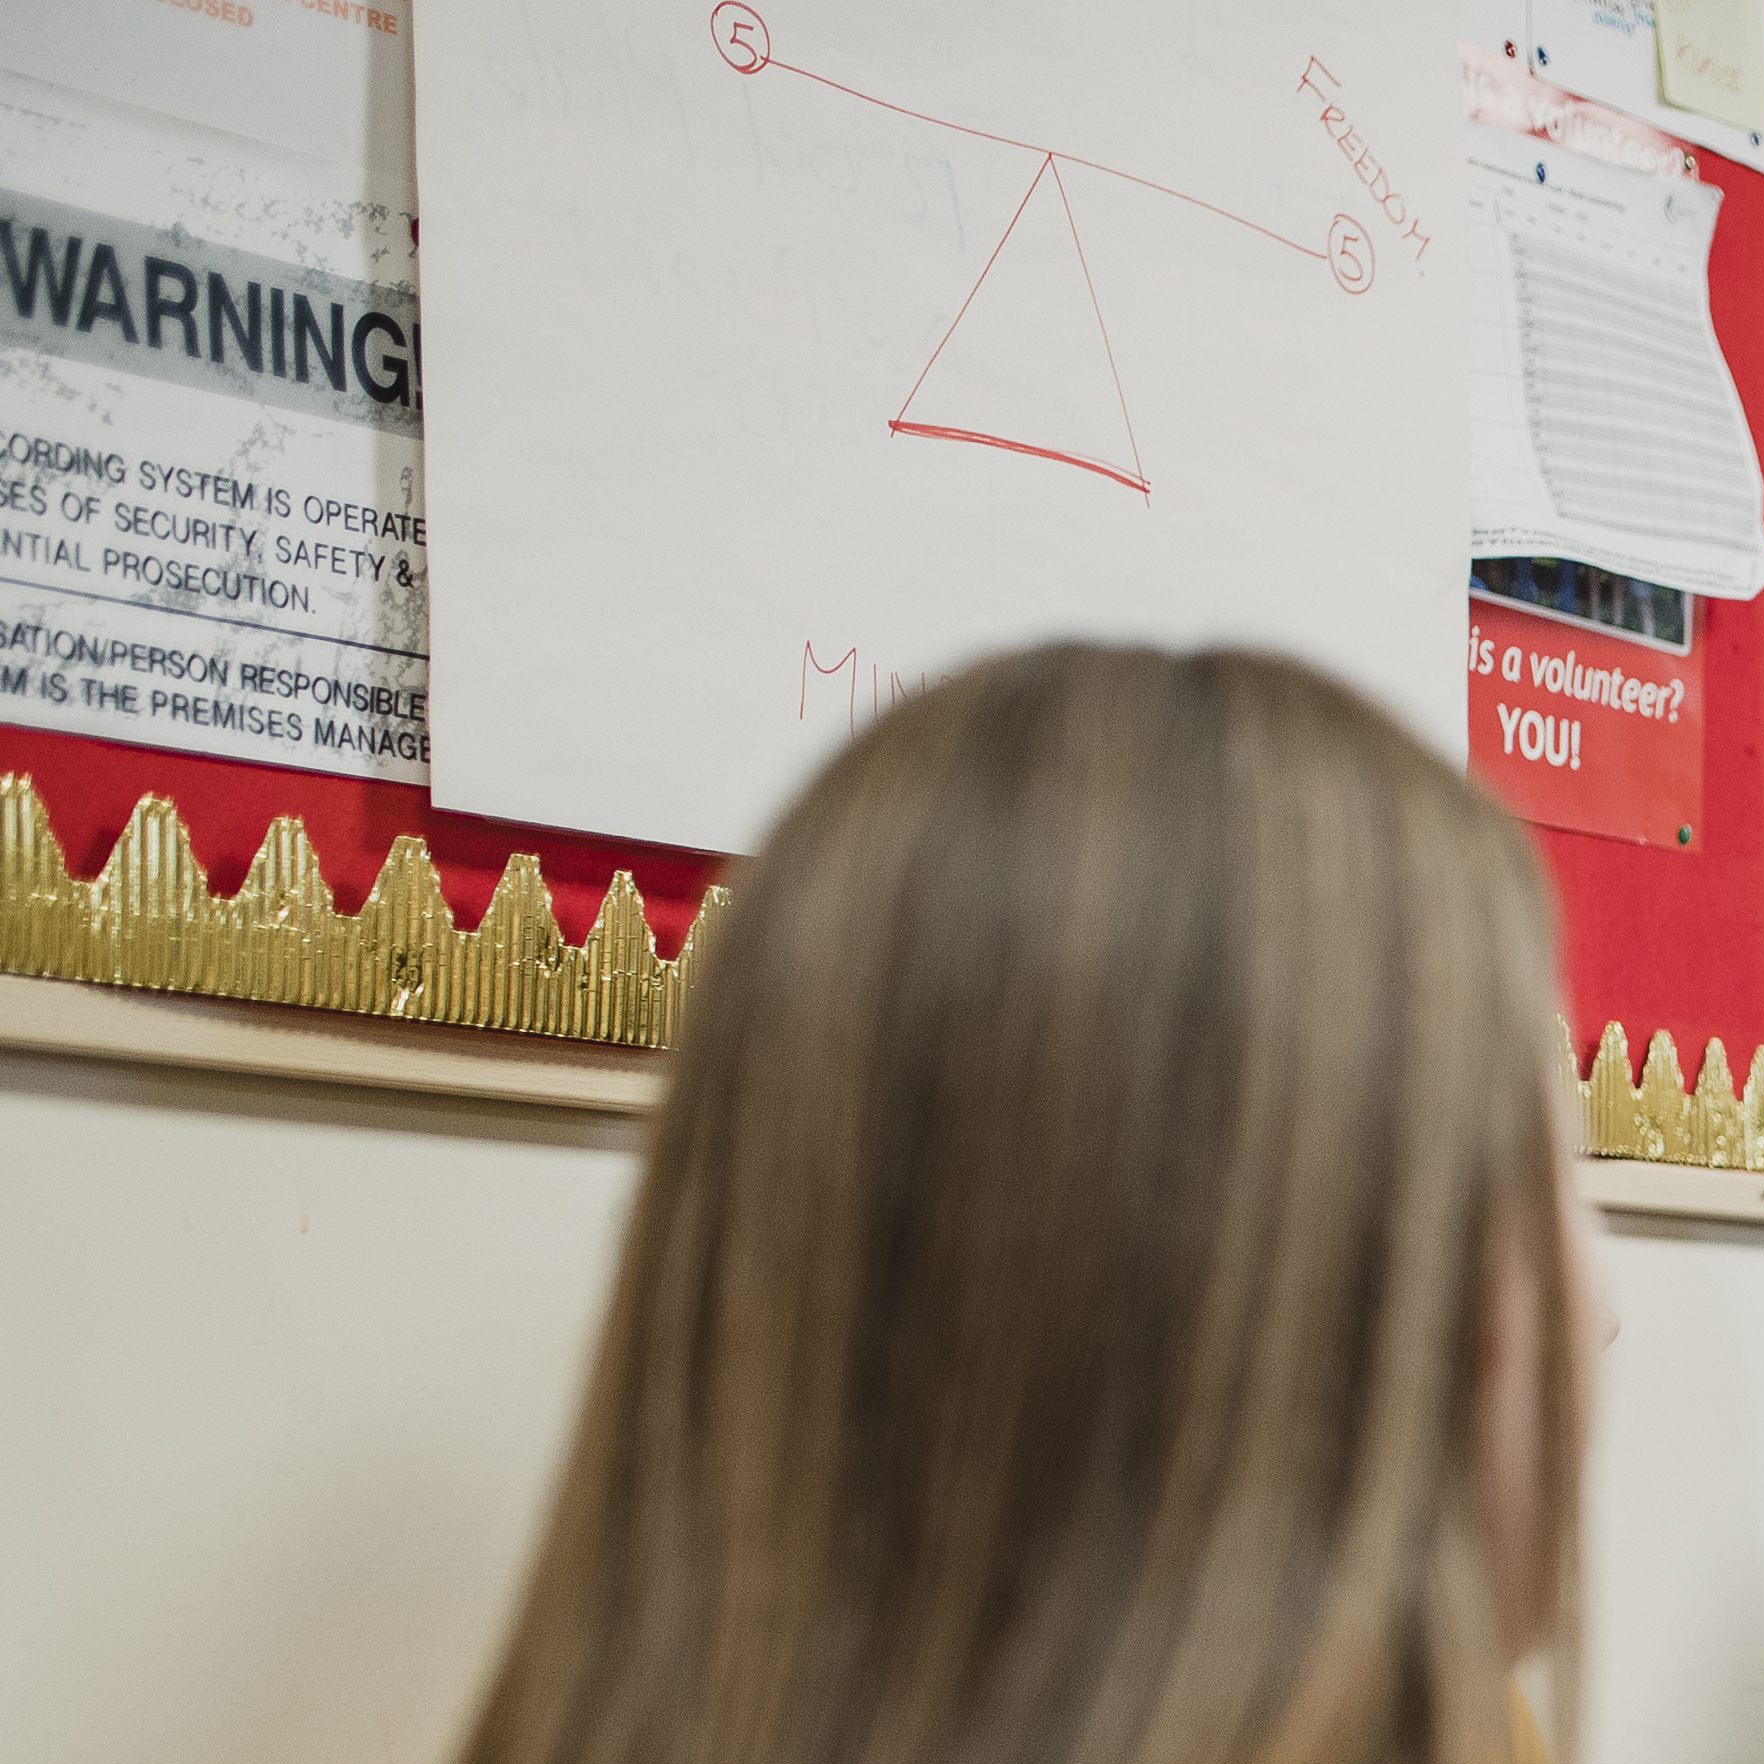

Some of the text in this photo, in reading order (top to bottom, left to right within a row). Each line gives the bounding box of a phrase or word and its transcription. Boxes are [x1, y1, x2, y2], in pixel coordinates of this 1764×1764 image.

[138, 460, 256, 512] SYSTEM
[266, 487, 292, 518] IS
[303, 495, 427, 548] OPERATE
[61, 491, 102, 525] OF
[114, 502, 264, 564] SECURITY,
[275, 535, 386, 582] SAFETY
[396, 559, 415, 589] &
[102, 547, 317, 615] PROSECUTION.
[41, 671, 69, 704] IS
[80, 677, 140, 715] THE
[151, 689, 304, 742] PREMISES
[239, 663, 427, 723] RESPONSIBLE
[1469, 625, 1685, 724] is a volunteer?
[1496, 701, 1582, 771] YOU!
